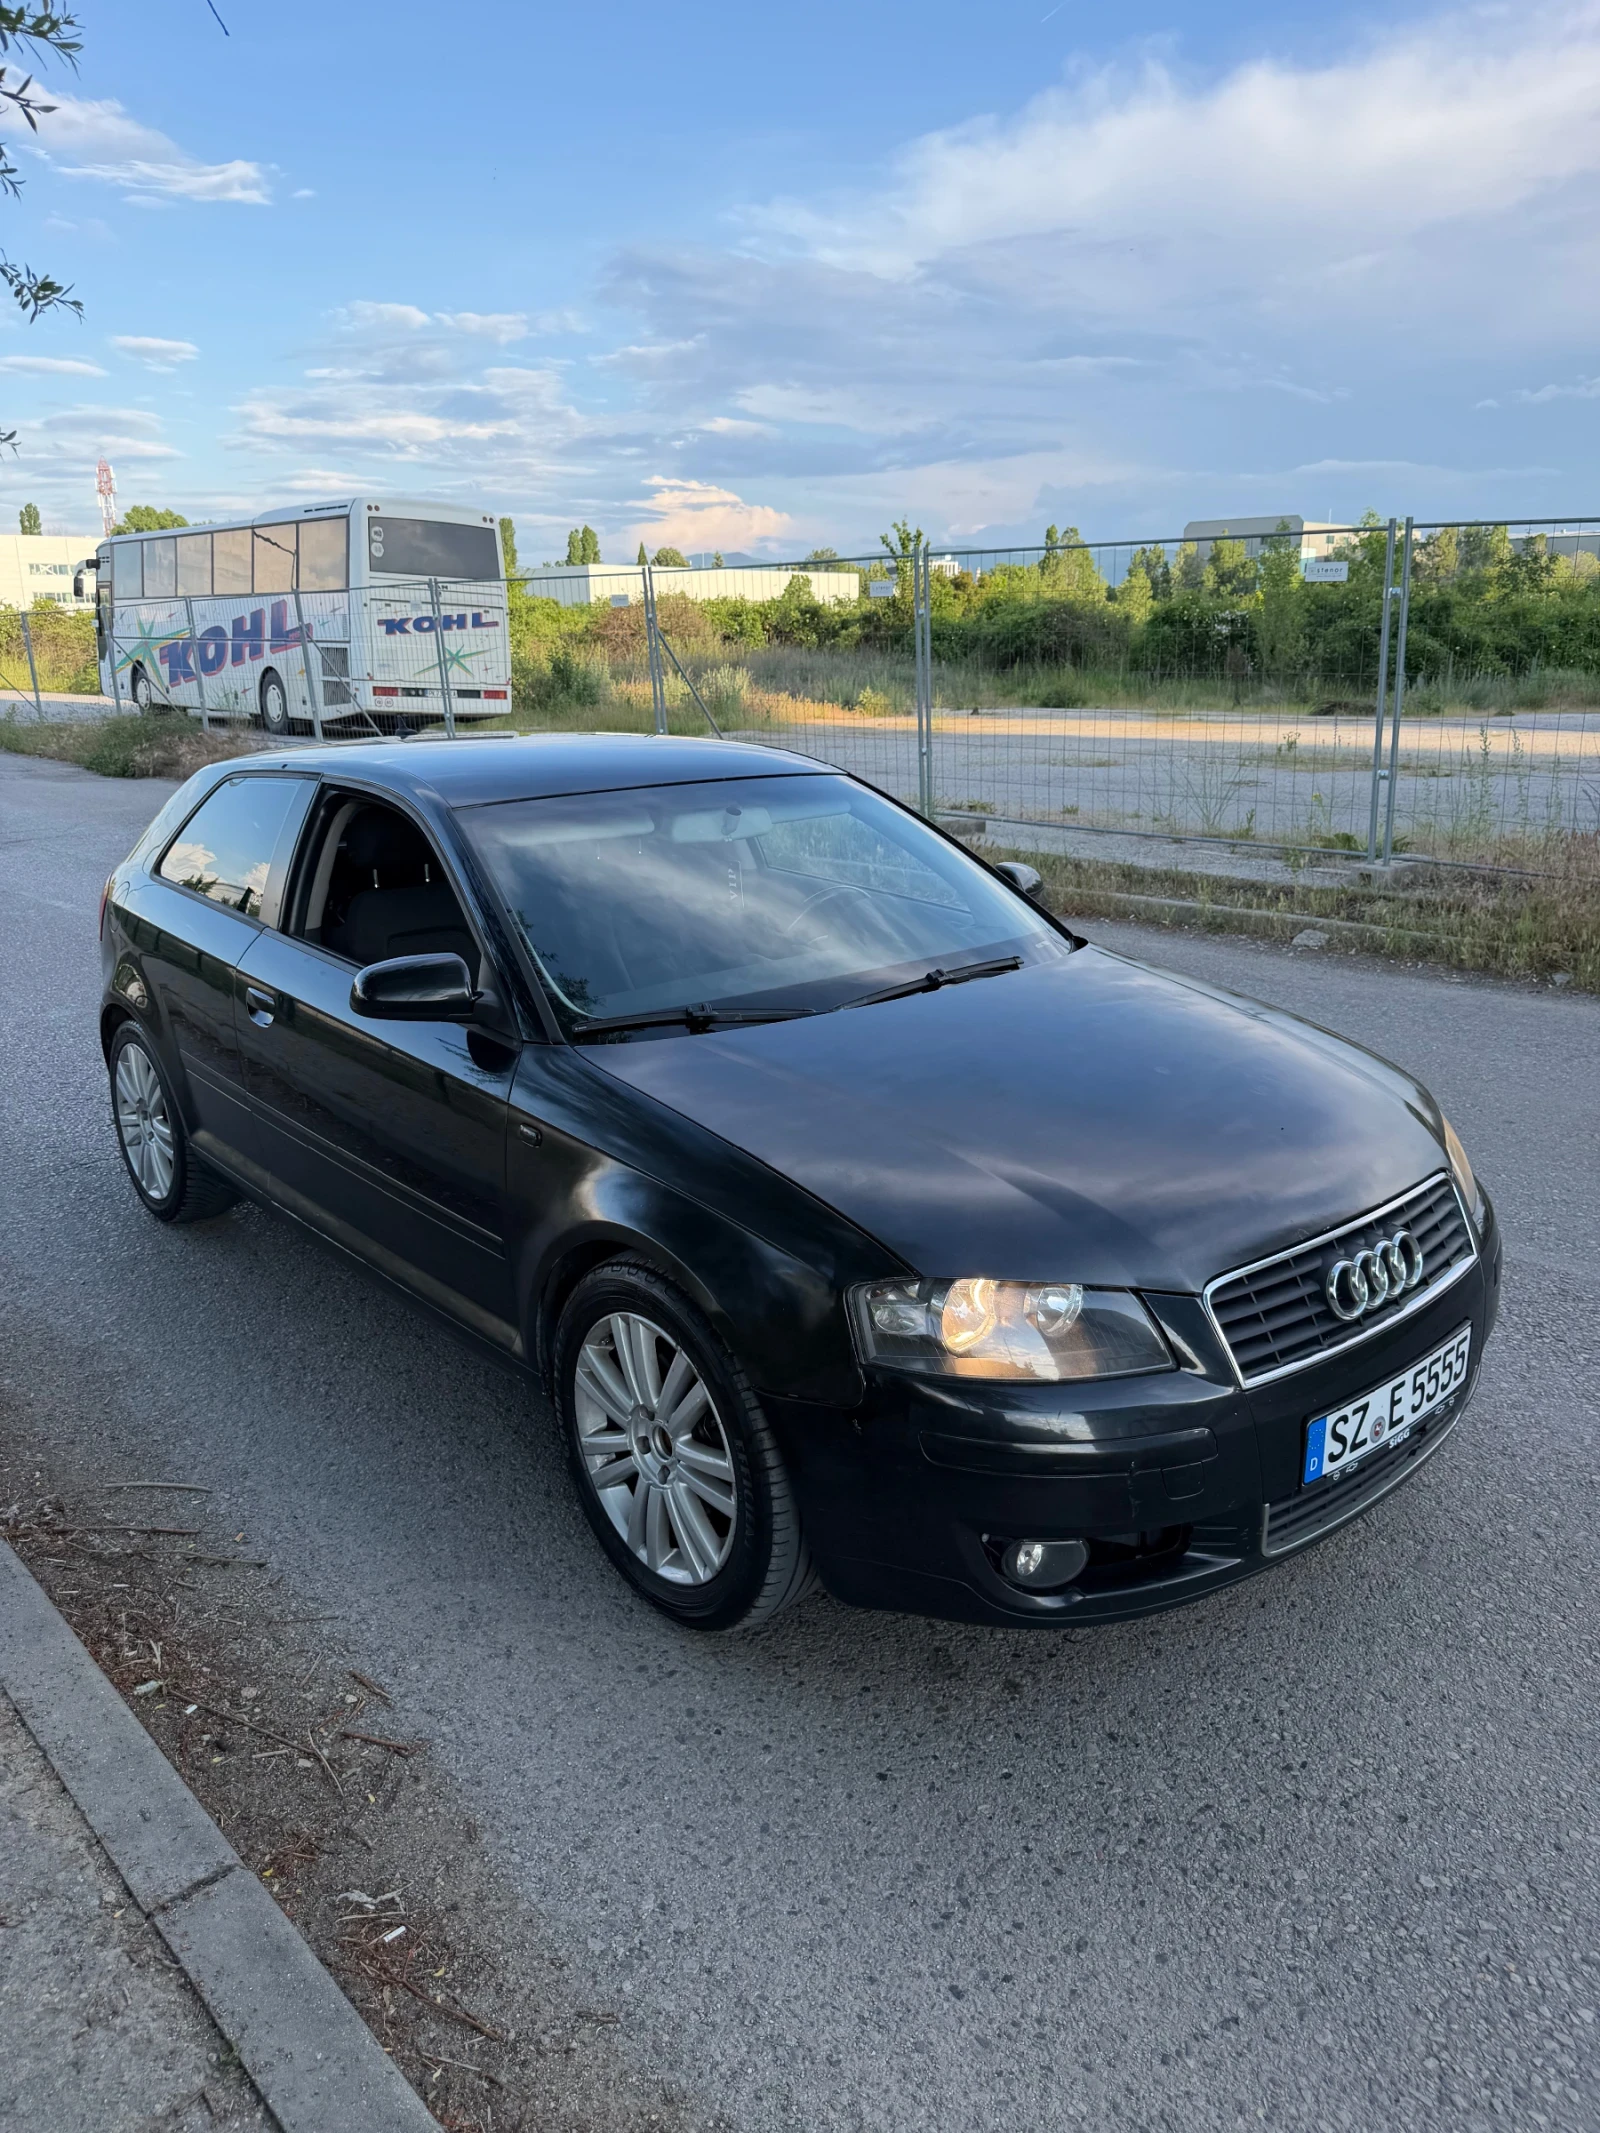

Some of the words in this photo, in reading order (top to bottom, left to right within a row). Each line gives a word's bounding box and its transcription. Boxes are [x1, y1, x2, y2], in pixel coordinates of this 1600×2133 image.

[159, 599, 313, 688] KOHL
[377, 611, 499, 635] KOHL
[728, 868, 738, 900] VIP
[1309, 1457, 1318, 1472] D
[1328, 1401, 1370, 1463] SZ
[1388, 1380, 1406, 1431] E
[1411, 1335, 1469, 1414] 5555
